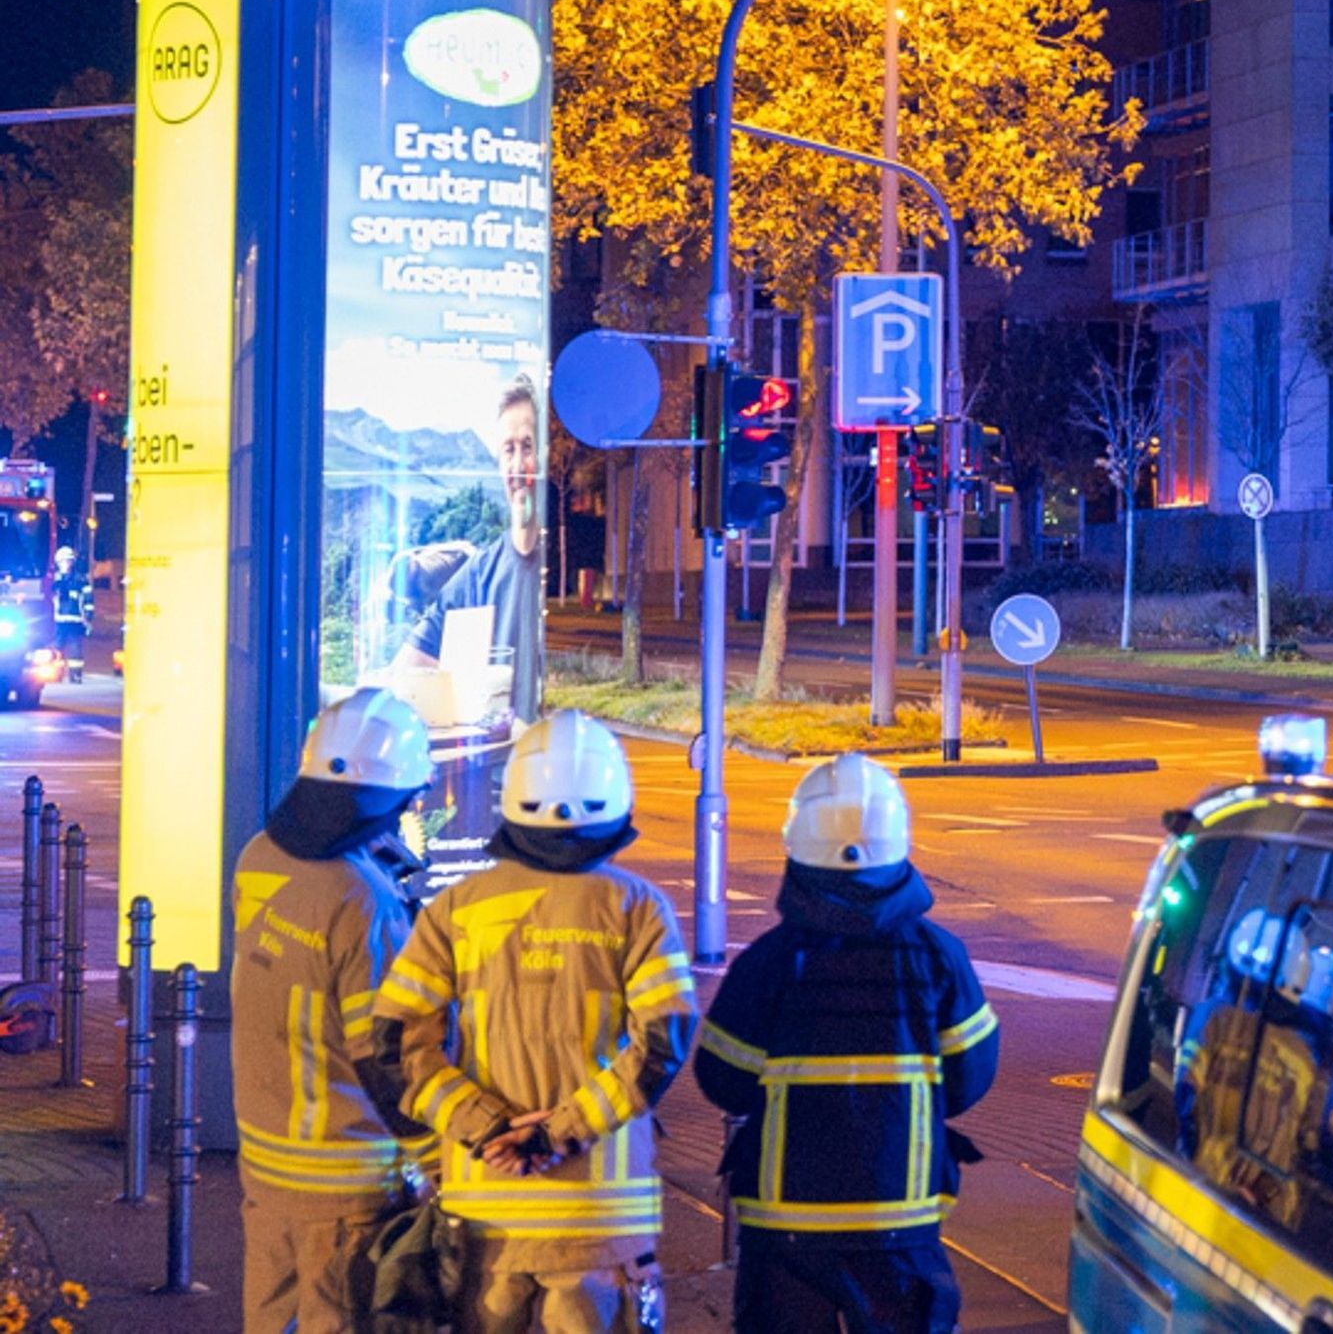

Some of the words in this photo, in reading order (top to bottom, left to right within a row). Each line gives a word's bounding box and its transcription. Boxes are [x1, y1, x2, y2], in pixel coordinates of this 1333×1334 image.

[153, 43, 209, 82] ARAG
[394, 123, 468, 161] Erst
[360, 164, 486, 204] Kräuter
[351, 216, 467, 253] sorgen
[472, 211, 513, 248] für
[873, 312, 916, 374] P
[522, 924, 625, 950] Feuerwehr
[521, 948, 565, 971] Köln
